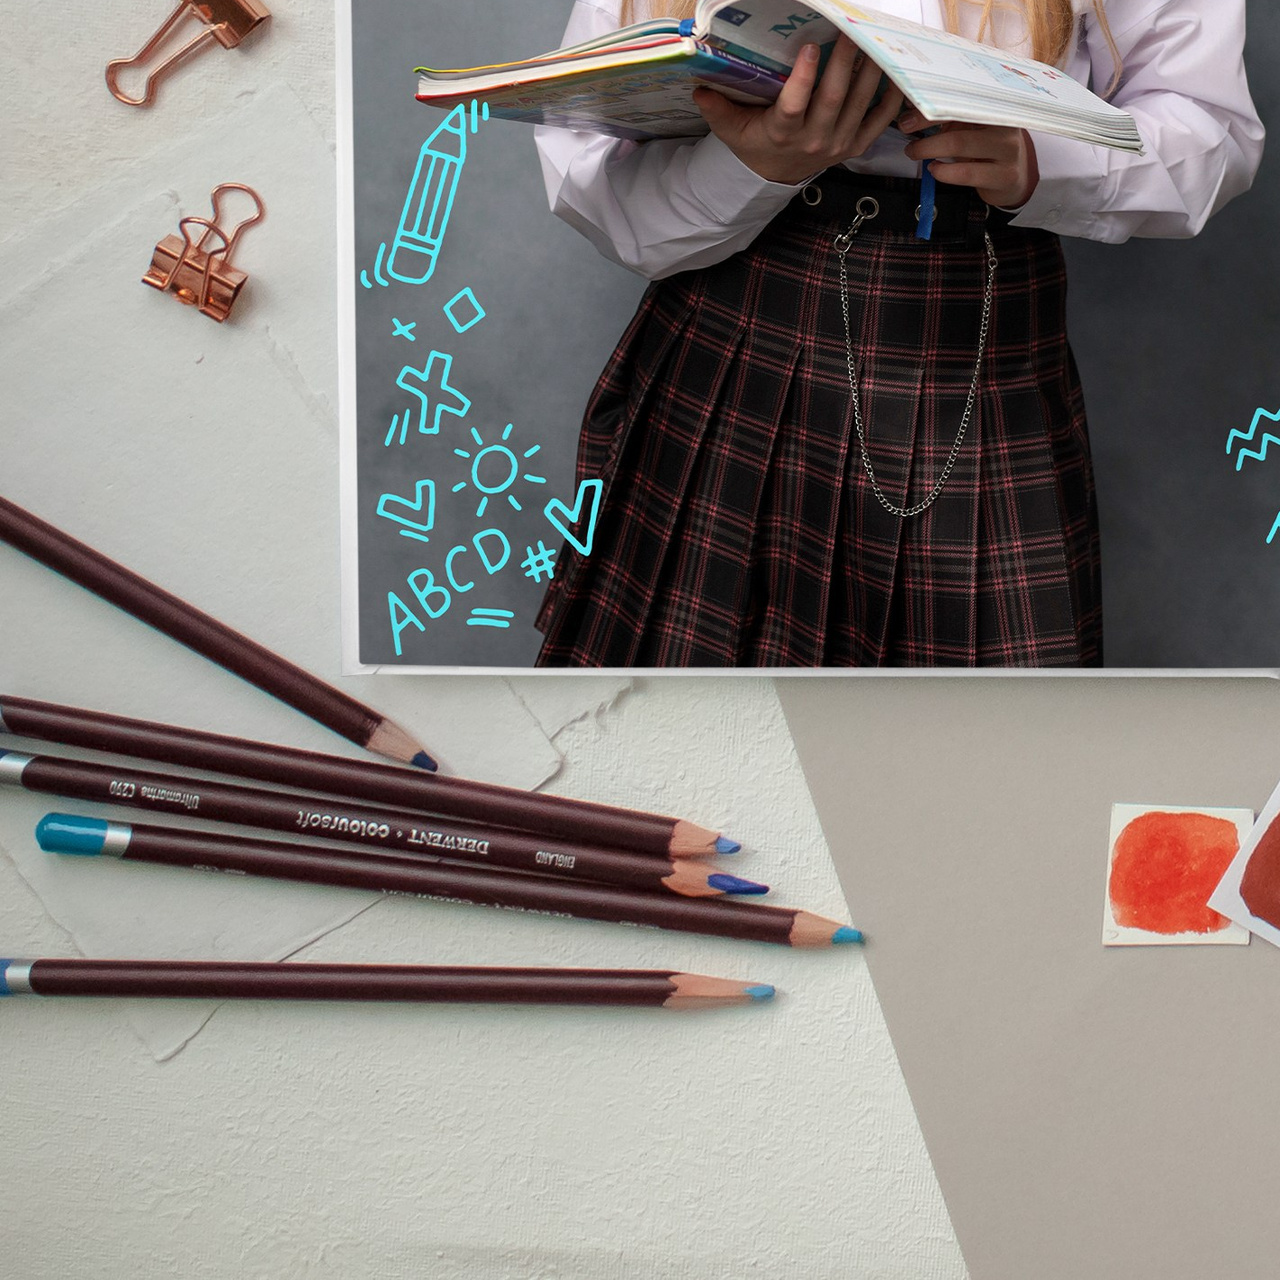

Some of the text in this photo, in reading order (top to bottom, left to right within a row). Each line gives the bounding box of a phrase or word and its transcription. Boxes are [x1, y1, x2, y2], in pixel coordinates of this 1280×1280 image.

[387, 528, 511, 656] ABCD
[140, 784, 201, 810] Ultramarine
[296, 810, 491, 855] DERWENT coloursoft
[535, 850, 576, 869] ENGLAND
